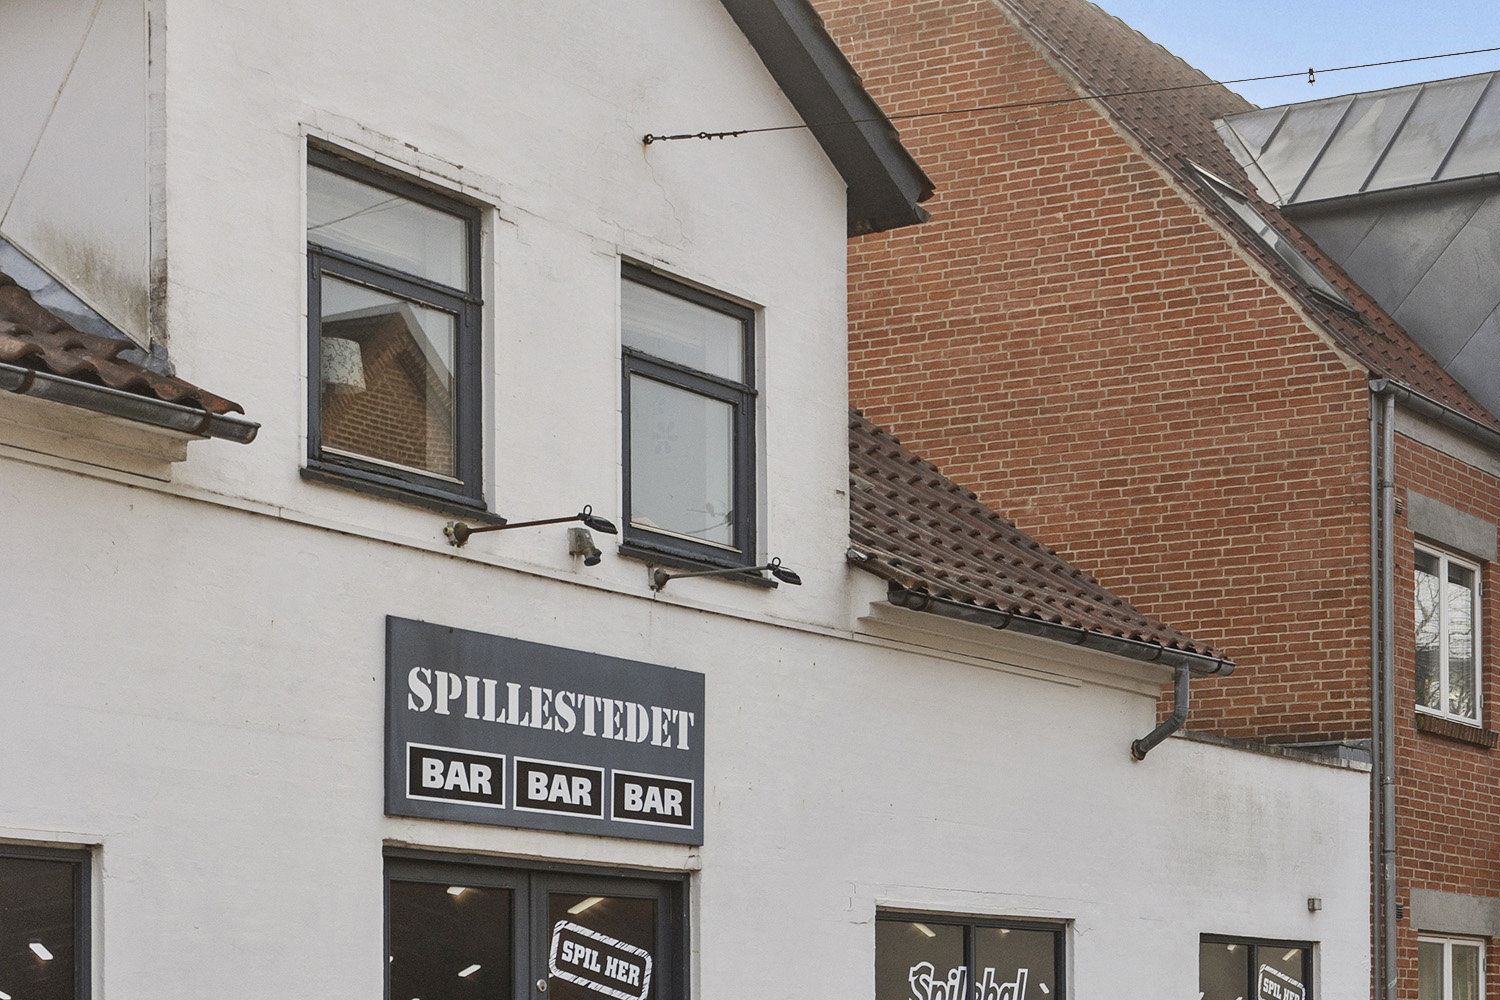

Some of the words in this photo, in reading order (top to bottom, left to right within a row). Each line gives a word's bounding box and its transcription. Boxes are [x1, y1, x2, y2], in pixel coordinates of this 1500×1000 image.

[407, 666, 695, 751] SPILLESTEDET
[422, 757, 492, 795] BAR
[527, 770, 592, 807] BAR
[624, 783, 683, 817] BAR
[561, 940, 602, 973] SPIL
[604, 955, 641, 987] HER
[1262, 977, 1282, 1000] SPIL
